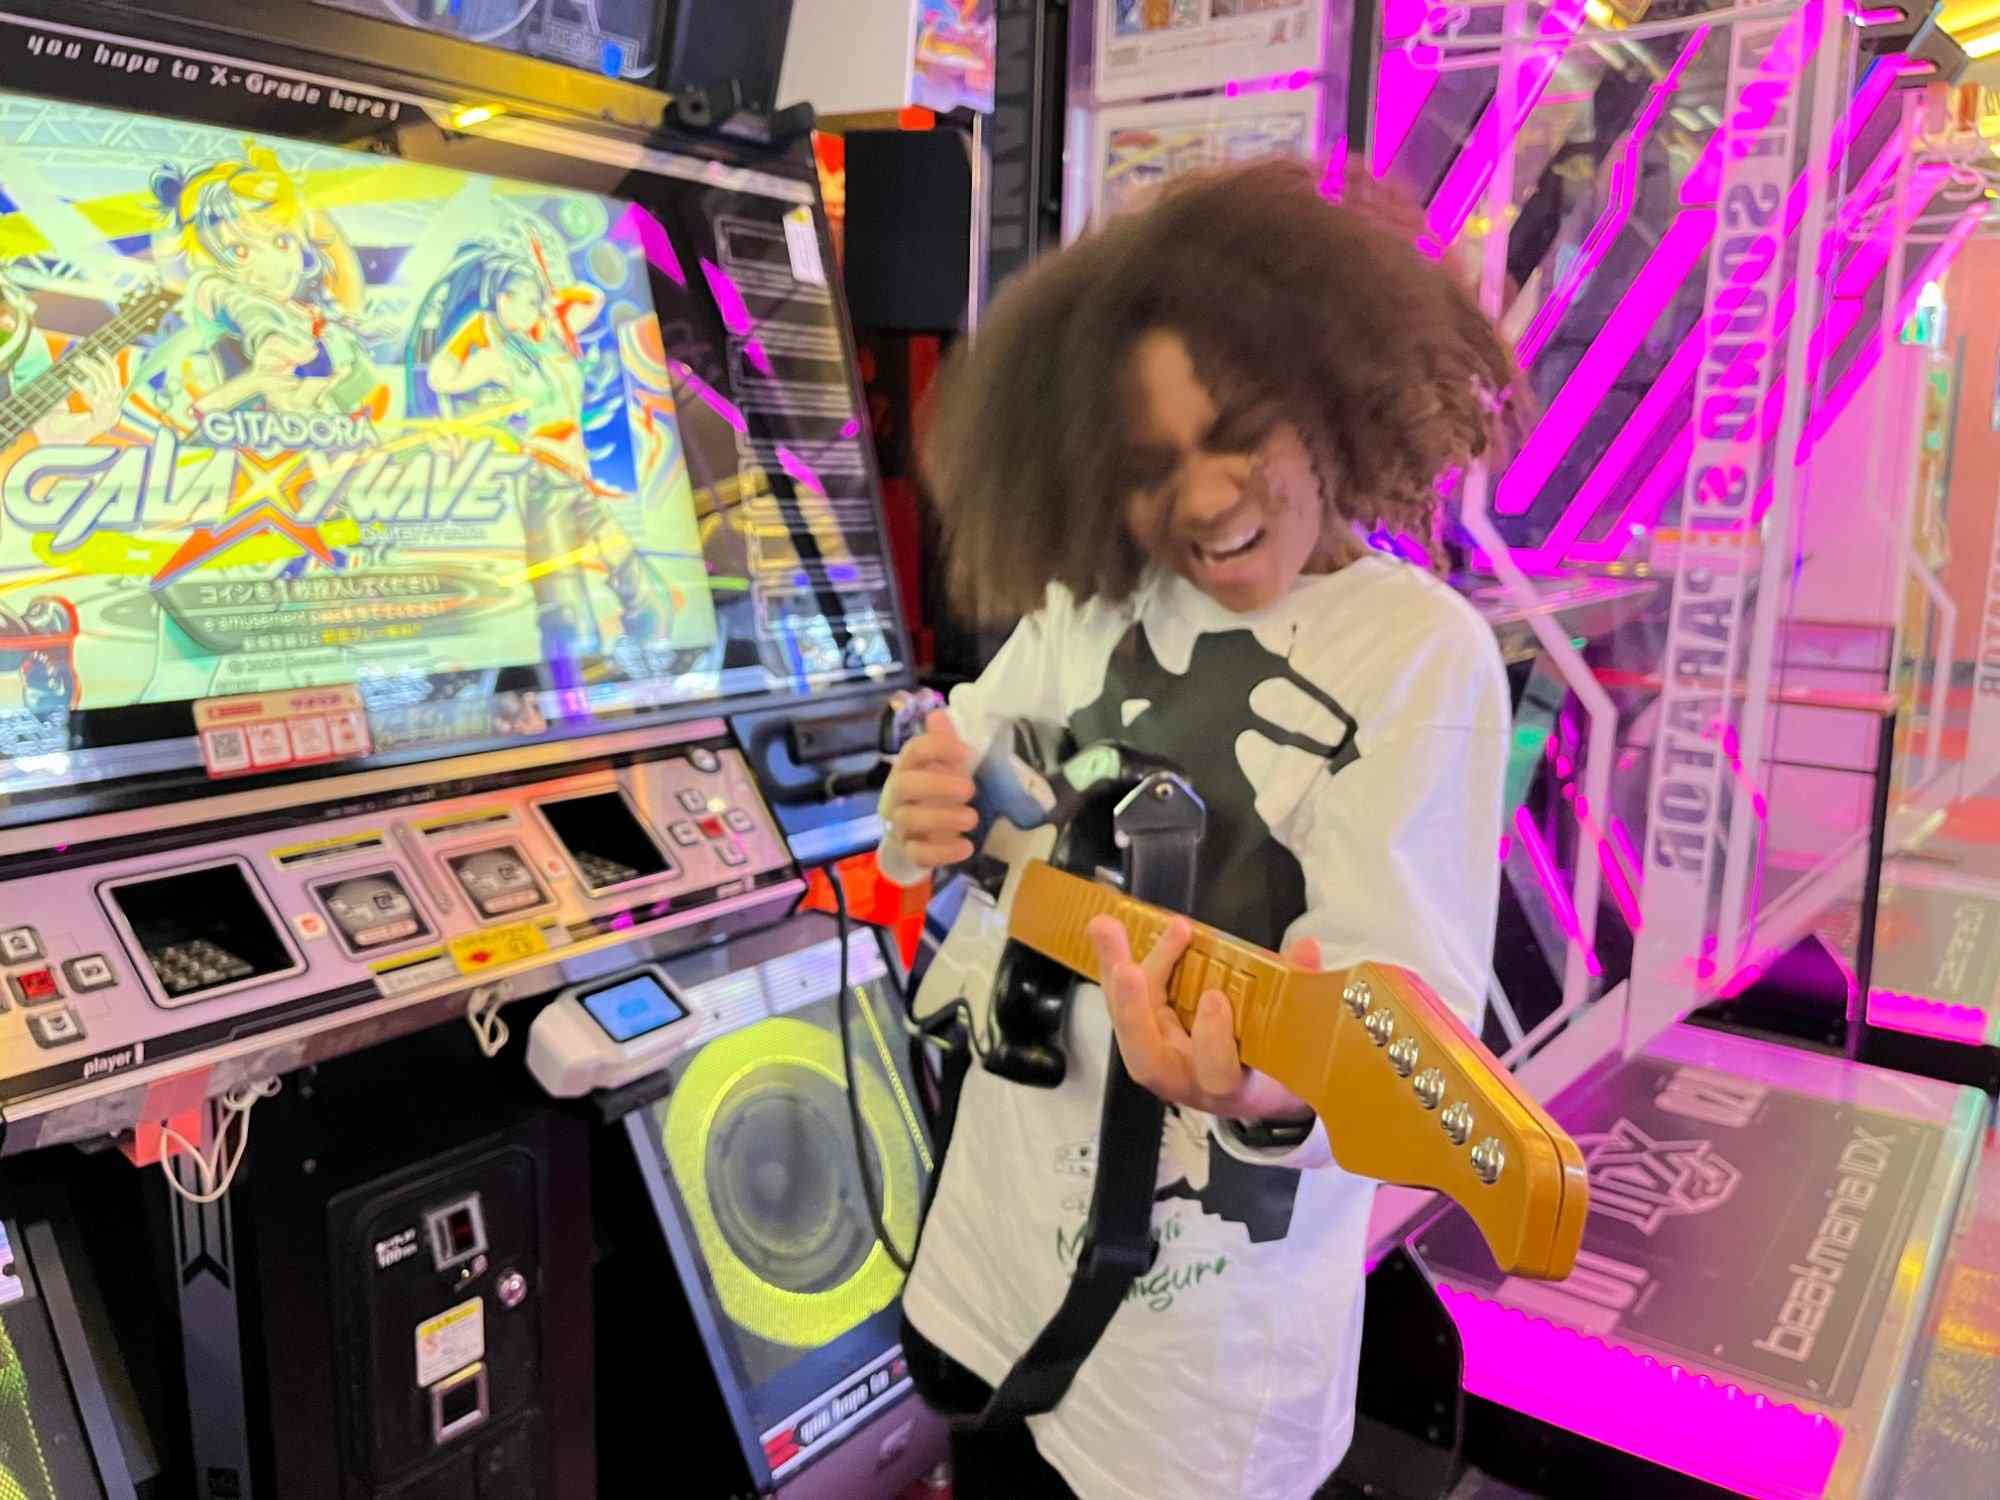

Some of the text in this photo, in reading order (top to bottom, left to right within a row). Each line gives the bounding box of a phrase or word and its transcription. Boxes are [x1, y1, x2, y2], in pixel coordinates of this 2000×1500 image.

[27, 35, 399, 120] you hope to X-Grade here!
[202, 411, 378, 446] GITADORA
[84, 1050, 133, 1079] player
[1752, 1176, 1878, 1362] beatmania
